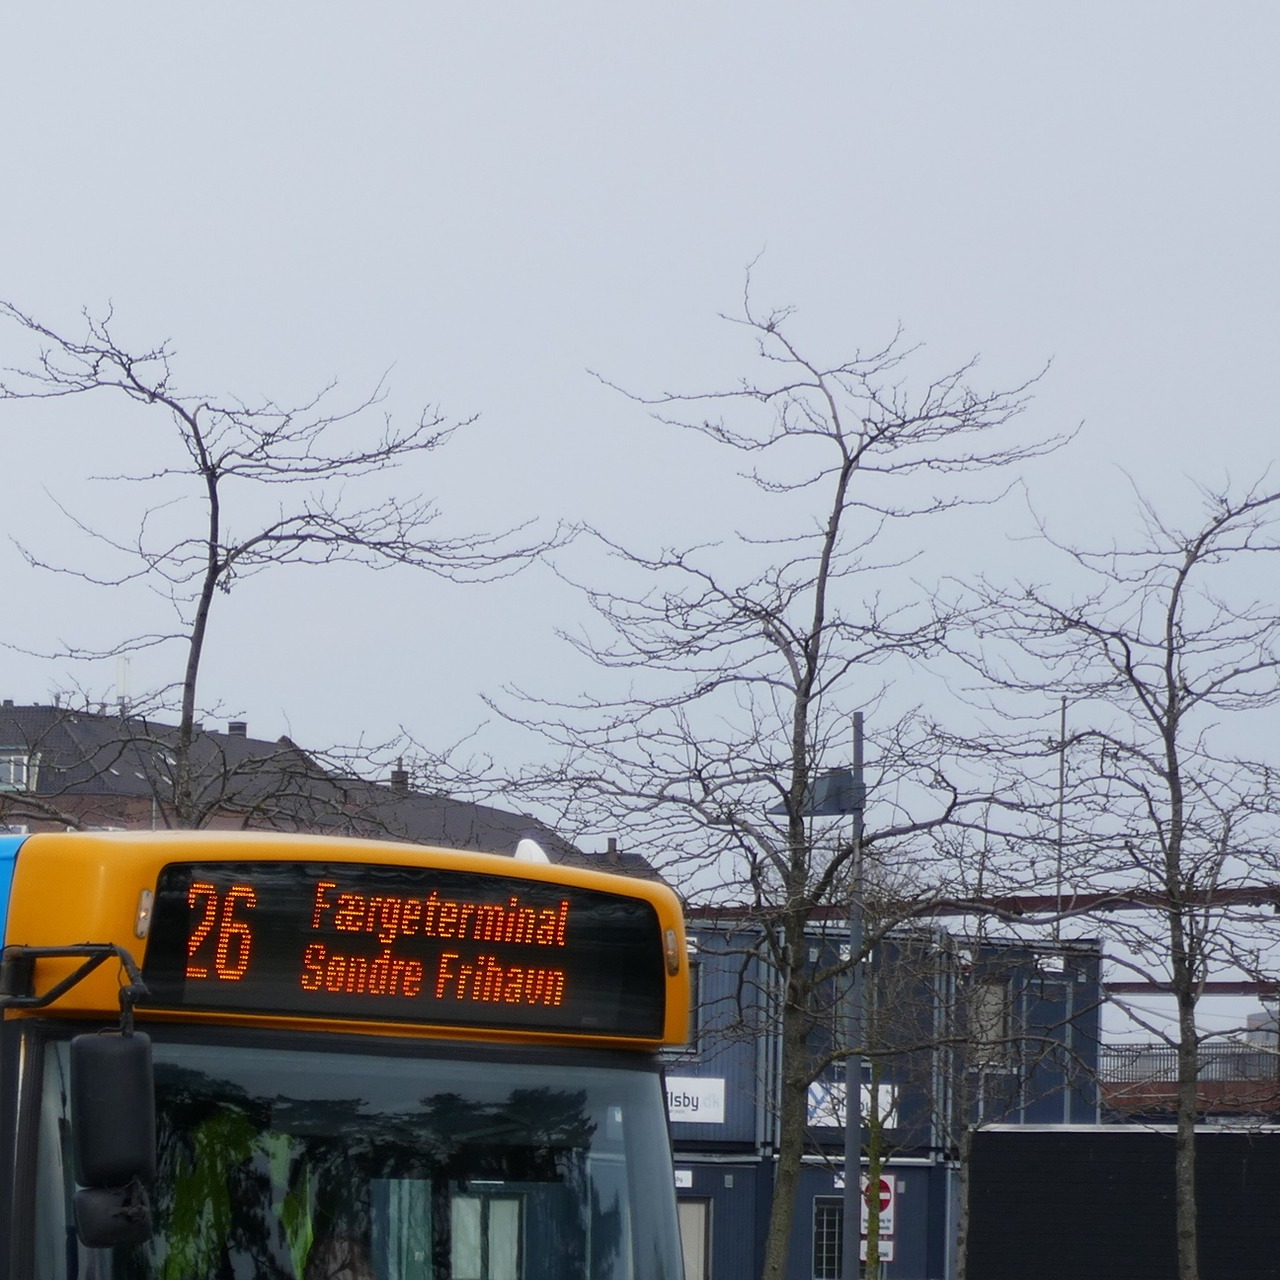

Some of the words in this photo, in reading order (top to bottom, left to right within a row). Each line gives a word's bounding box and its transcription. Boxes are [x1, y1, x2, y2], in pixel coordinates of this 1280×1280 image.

[185, 882, 257, 981] 26
[310, 881, 570, 946] Færgeterminal
[435, 952, 566, 1006] Frihavn
